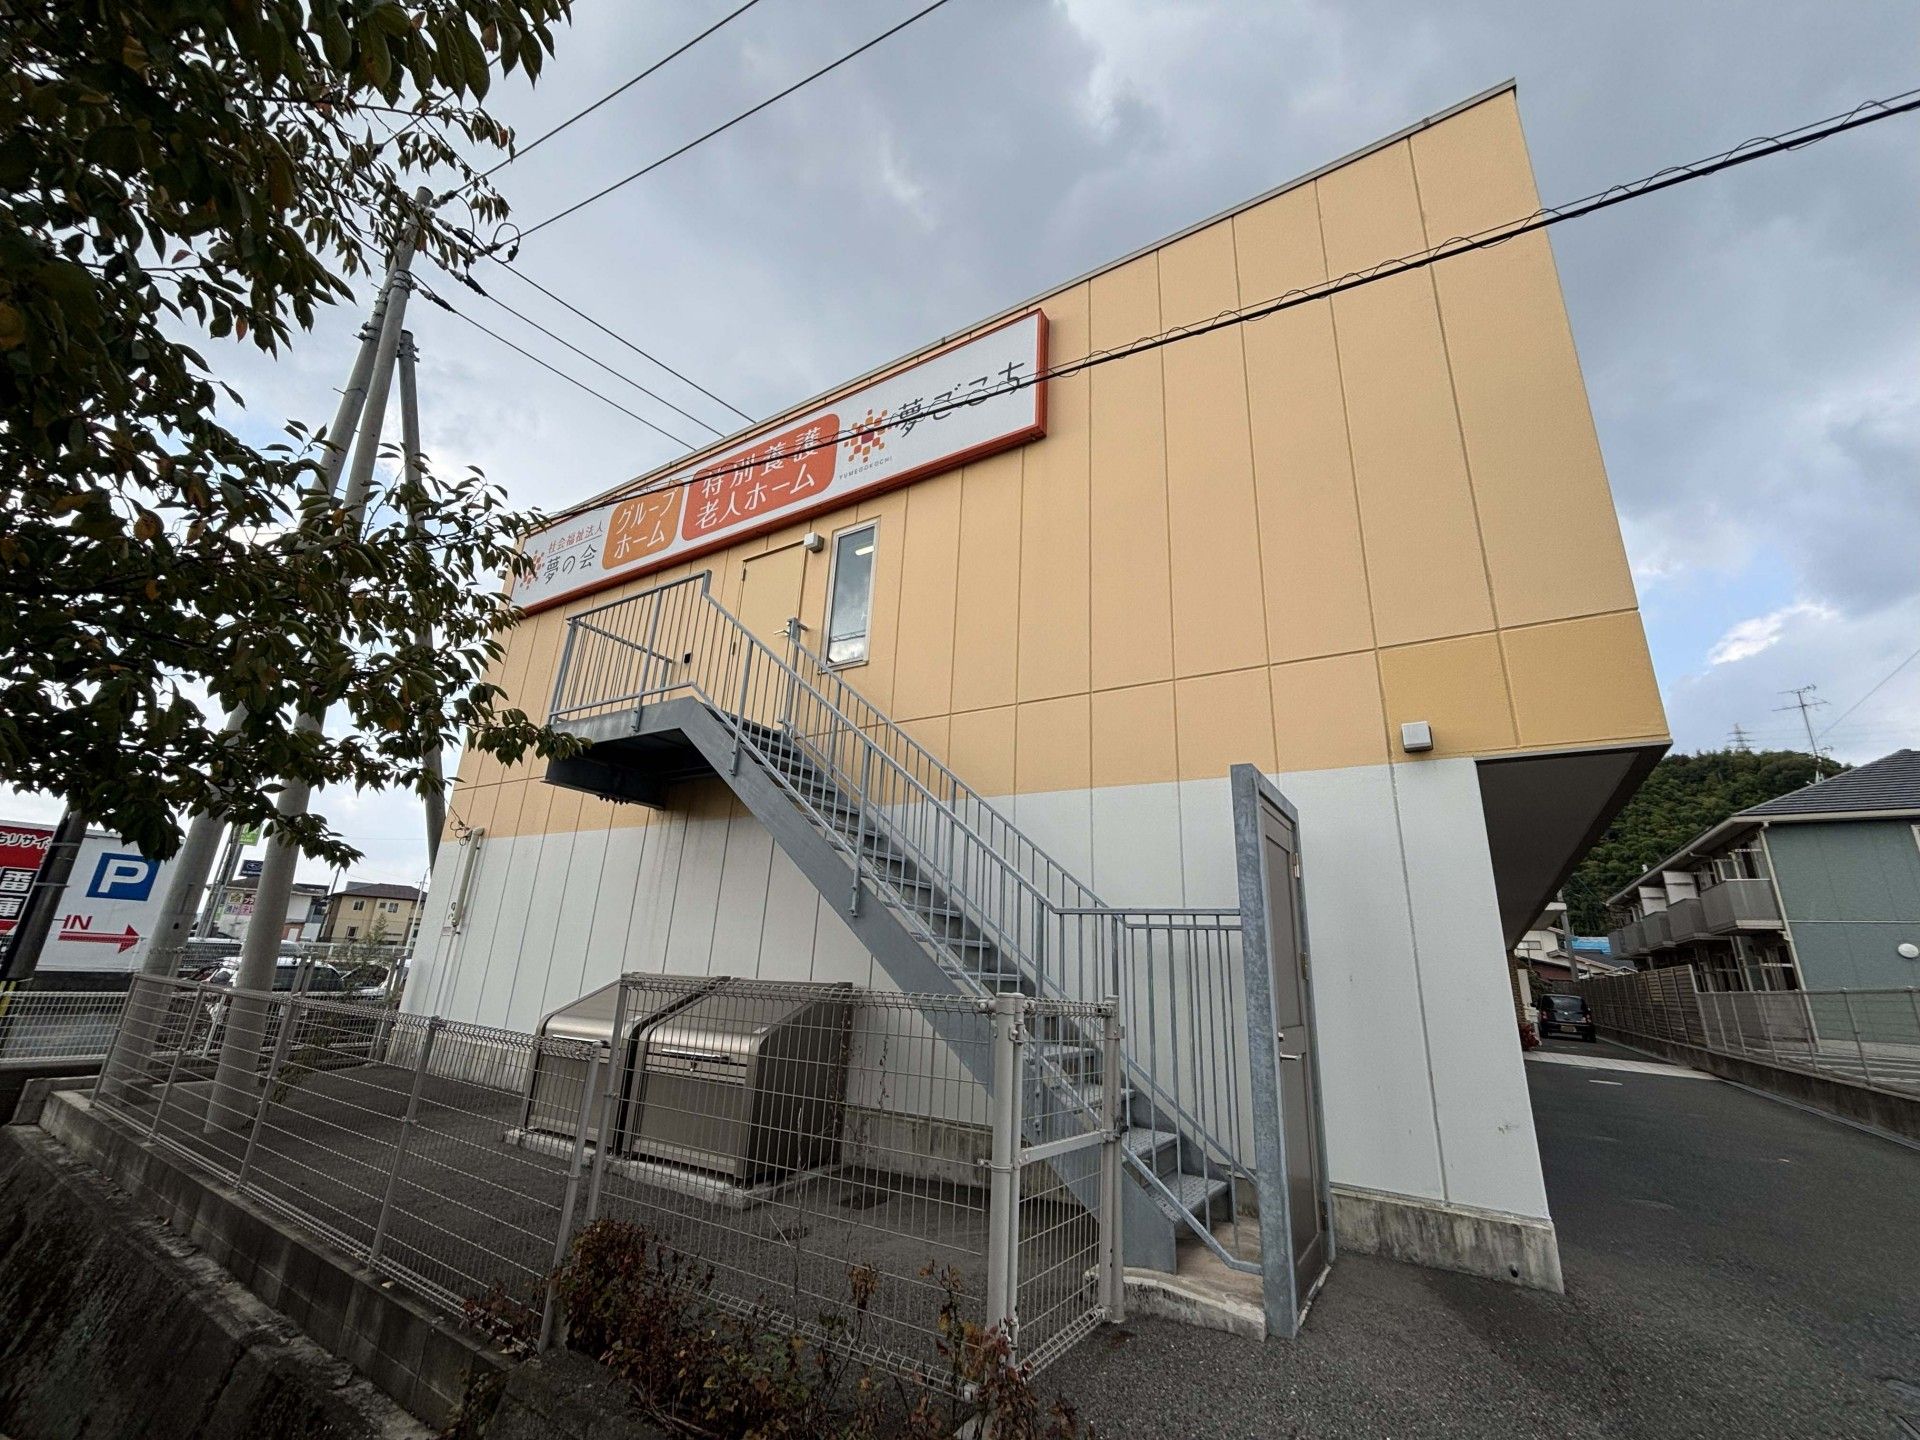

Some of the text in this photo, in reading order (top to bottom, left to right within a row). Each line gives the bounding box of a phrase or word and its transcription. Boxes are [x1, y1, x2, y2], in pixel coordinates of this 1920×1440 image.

[896, 361, 1025, 438] 夢ごこち
[701, 426, 821, 499] 特別養護
[839, 455, 893, 479] YUMEGOKOCHI
[615, 486, 679, 534] グループ
[695, 463, 815, 529] 老人ホーム
[548, 520, 603, 554] 社会福祉法人
[614, 520, 665, 558] ホーム
[543, 543, 597, 585] 夢の会
[97, 859, 149, 893] P
[62, 914, 93, 930] IN
